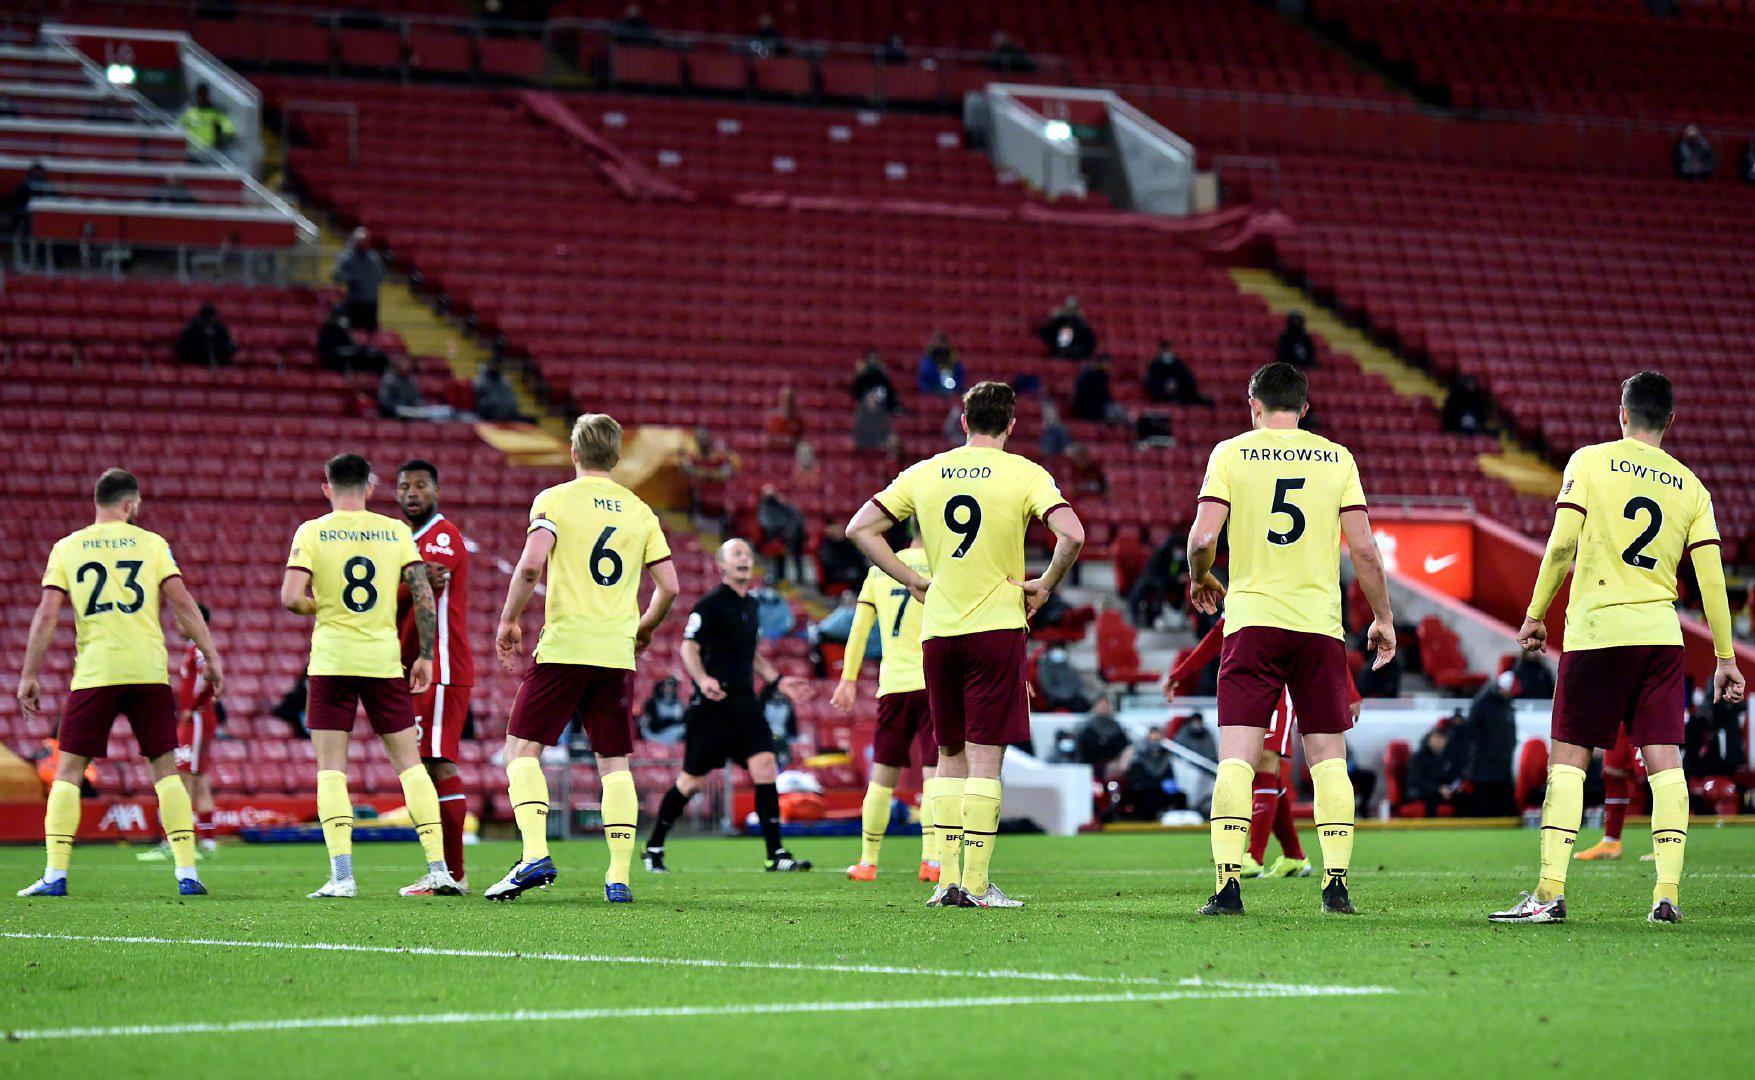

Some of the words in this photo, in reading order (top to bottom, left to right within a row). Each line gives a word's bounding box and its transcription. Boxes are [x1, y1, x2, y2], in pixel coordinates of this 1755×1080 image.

[1240, 448, 1339, 462] TARKOWSKI
[941, 467, 991, 479] WOOD
[1610, 458, 1683, 490] LOWTON
[594, 498, 622, 512] MEE
[1267, 478, 1306, 545] 5
[319, 529, 399, 542] BROWNHILL
[944, 494, 982, 558] 9
[1622, 496, 1662, 570] 2
[82, 537, 136, 550] PIETERS
[590, 526, 623, 586] 6
[77, 560, 145, 616] 23
[343, 556, 378, 613] 8
[890, 588, 911, 636] 7
[610, 832, 631, 840] BFC
[1224, 824, 1248, 833] BFC
